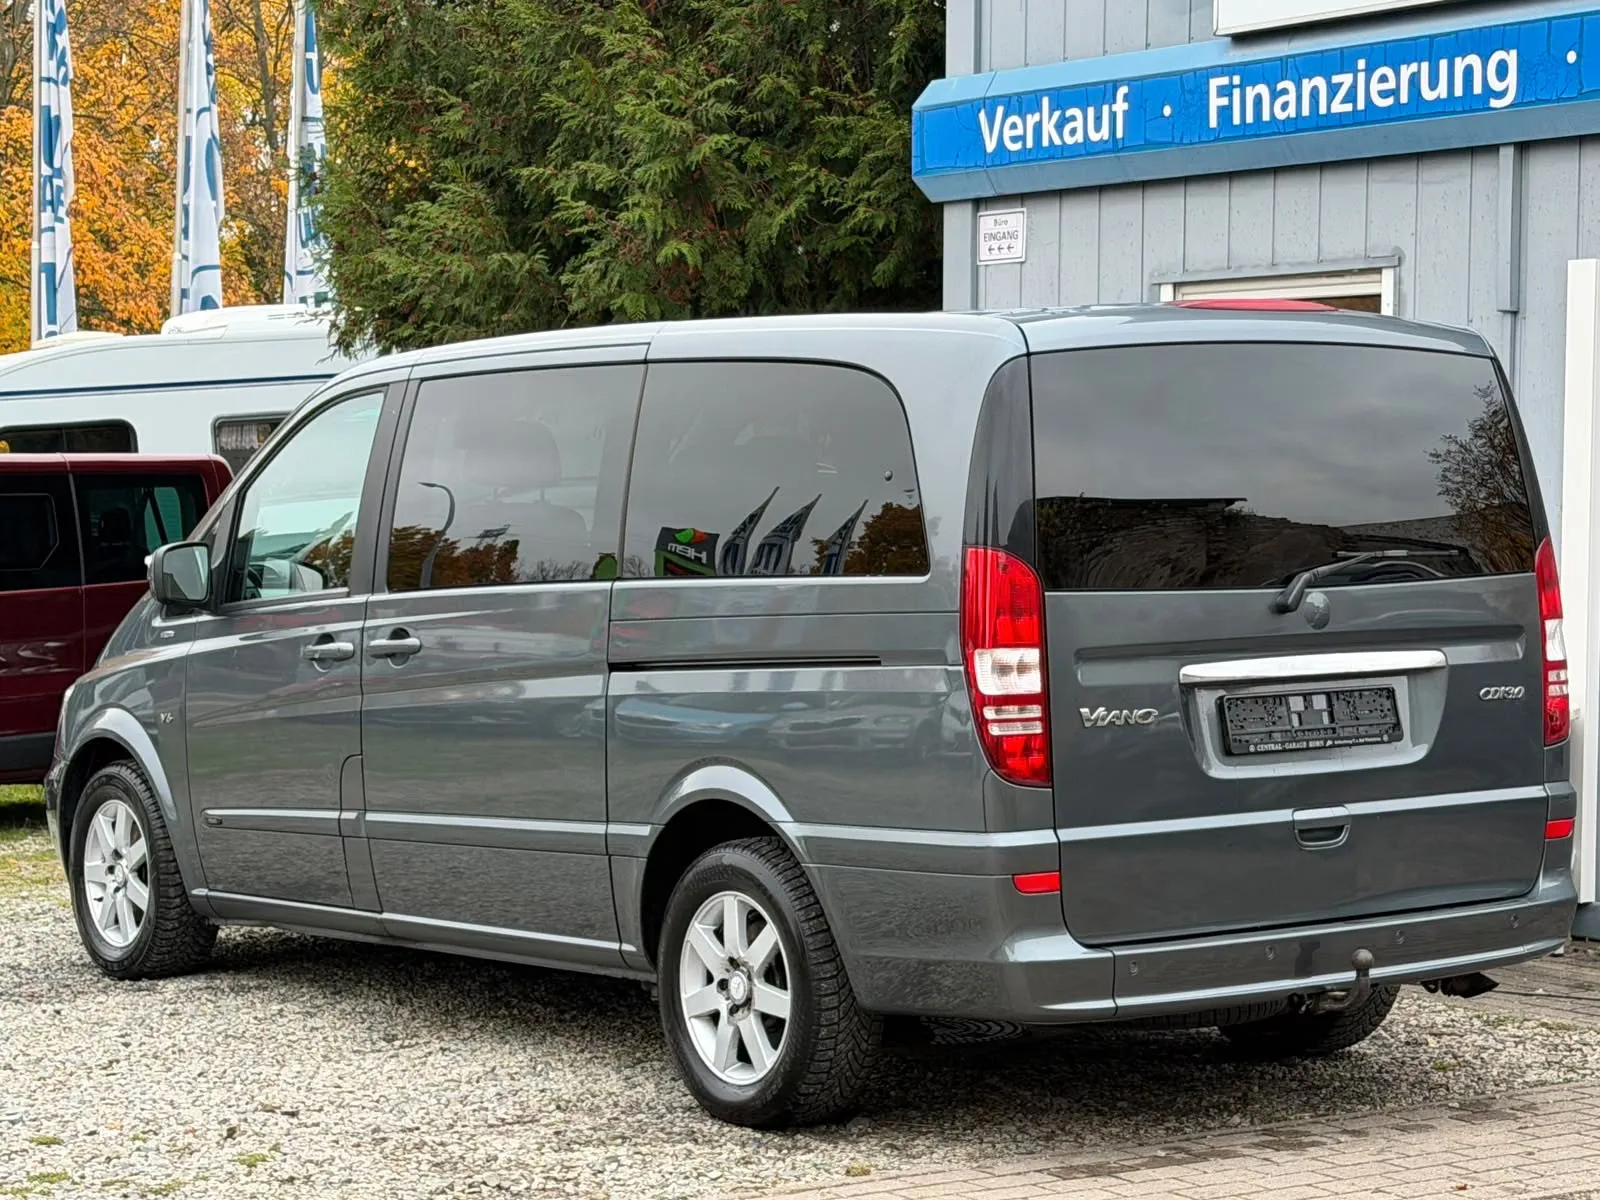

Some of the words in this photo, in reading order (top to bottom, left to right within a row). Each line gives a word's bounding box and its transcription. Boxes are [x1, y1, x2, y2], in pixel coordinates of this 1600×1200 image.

[978, 85, 1129, 153] Verkauf
[1208, 48, 1518, 129] Finanzierung
[983, 229, 1019, 243] EINGANG
[160, 712, 174, 724] V6
[1079, 706, 1159, 728] VIANO
